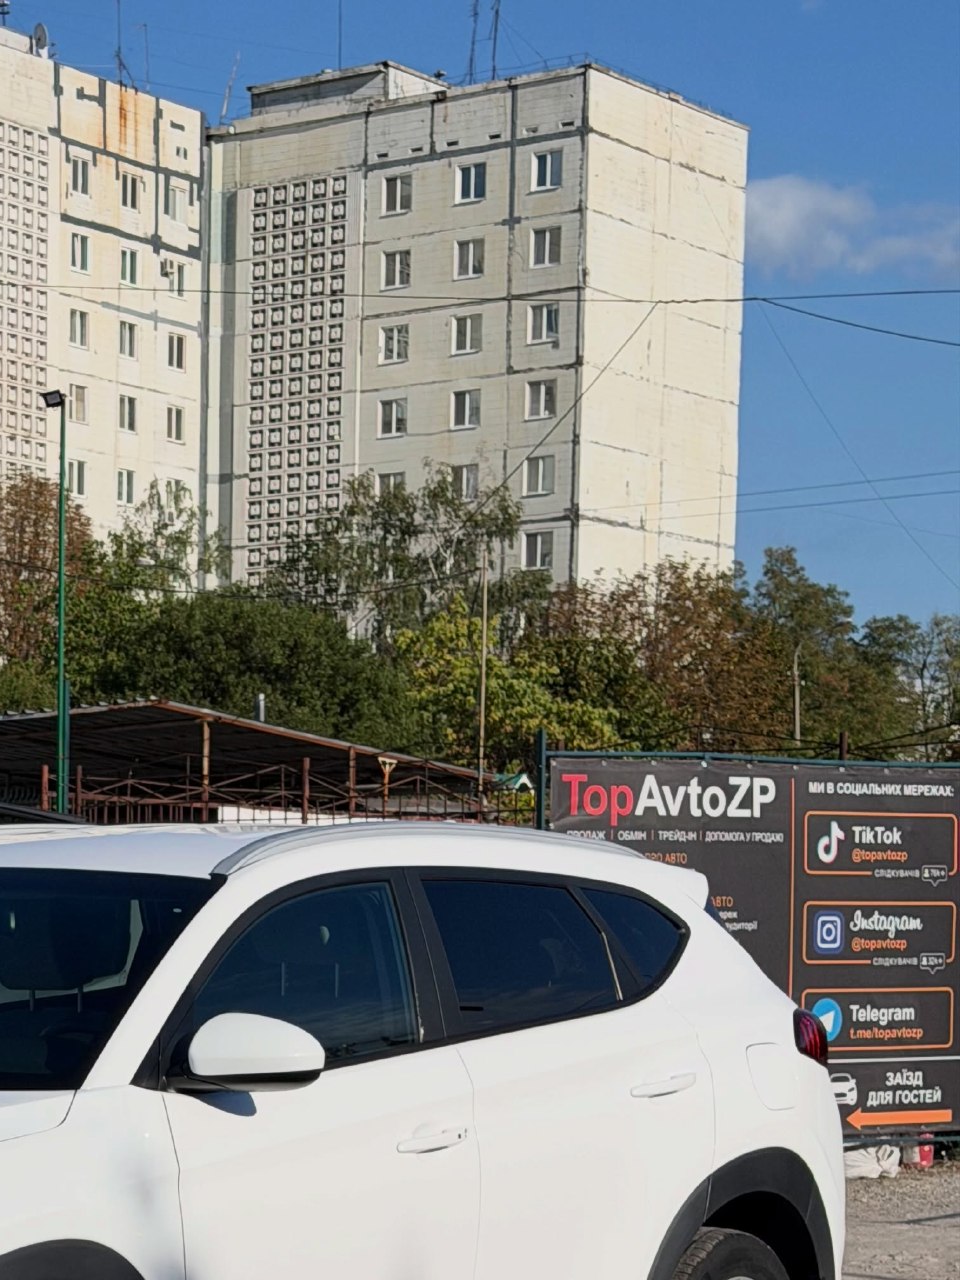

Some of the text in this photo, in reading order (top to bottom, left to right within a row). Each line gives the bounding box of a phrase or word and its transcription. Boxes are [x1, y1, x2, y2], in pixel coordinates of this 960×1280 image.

[808, 781, 955, 797] МИ В СОЦІАЛЬНИХ МЕРЕЖАХ:
[562, 773, 776, 826] TopAvtoZP
[618, 831, 647, 841] ОБМІН
[658, 829, 697, 842] ТРЕЙД-ІН
[705, 831, 745, 842] ДОПОМОГА
[745, 832, 751, 842] У
[852, 826, 902, 845] TikTok
[665, 853, 688, 864] АВТО
[852, 848, 908, 863] @topavtozp
[849, 910, 923, 938] Instagram
[851, 937, 907, 952] @topavtozp
[849, 1004, 915, 1026] Telegram
[849, 1027, 923, 1040] t.me/topavtozp
[885, 1068, 923, 1087] ЗАЇЗД
[866, 1086, 942, 1107] ДЛЯ ГОСТЕЙ
